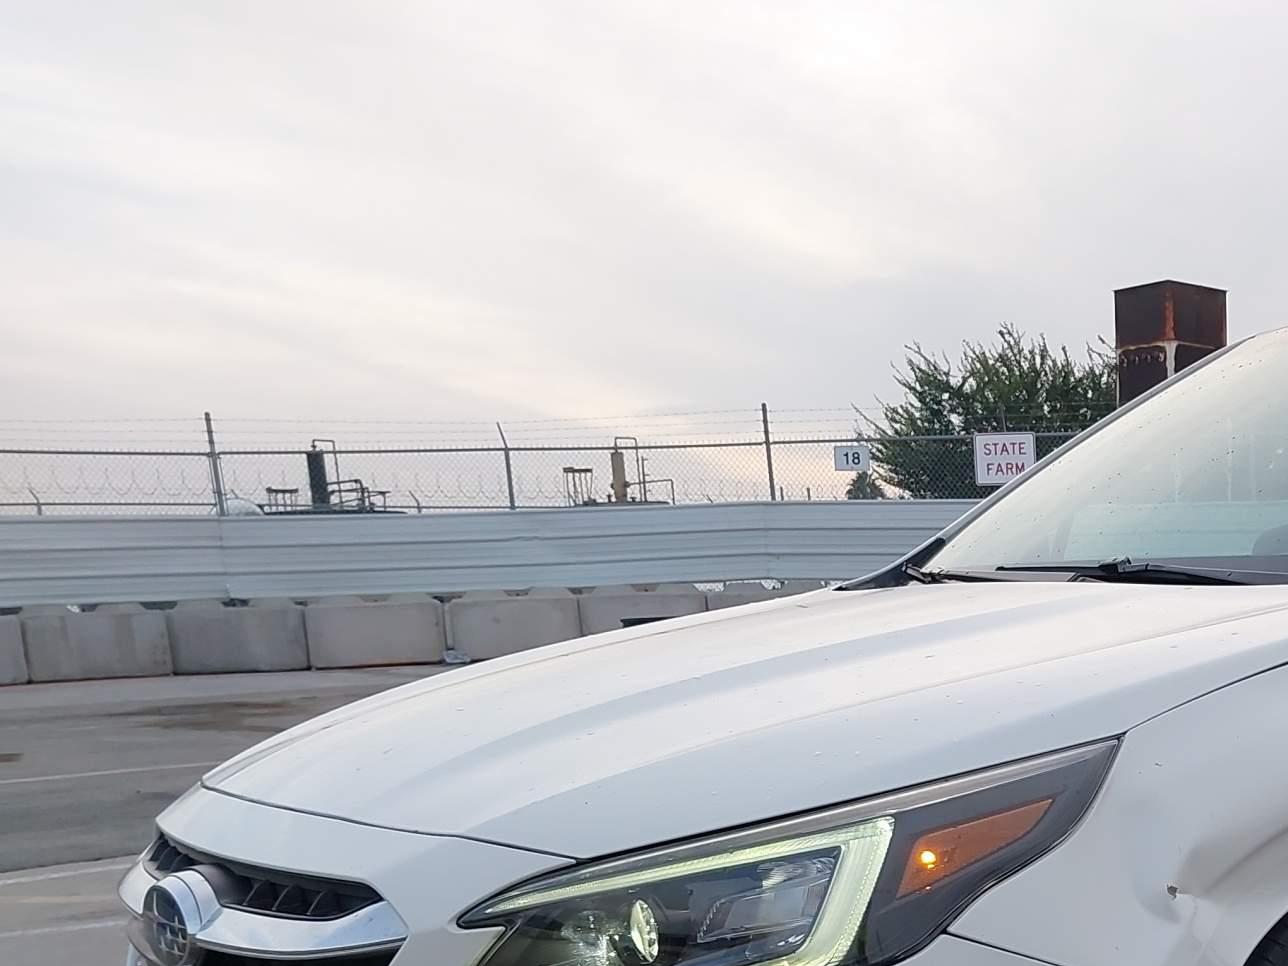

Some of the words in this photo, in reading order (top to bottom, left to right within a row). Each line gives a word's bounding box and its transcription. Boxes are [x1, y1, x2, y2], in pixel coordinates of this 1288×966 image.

[983, 442, 1027, 456] STATE
[843, 451, 861, 466] 18
[986, 462, 1026, 477] FARM
